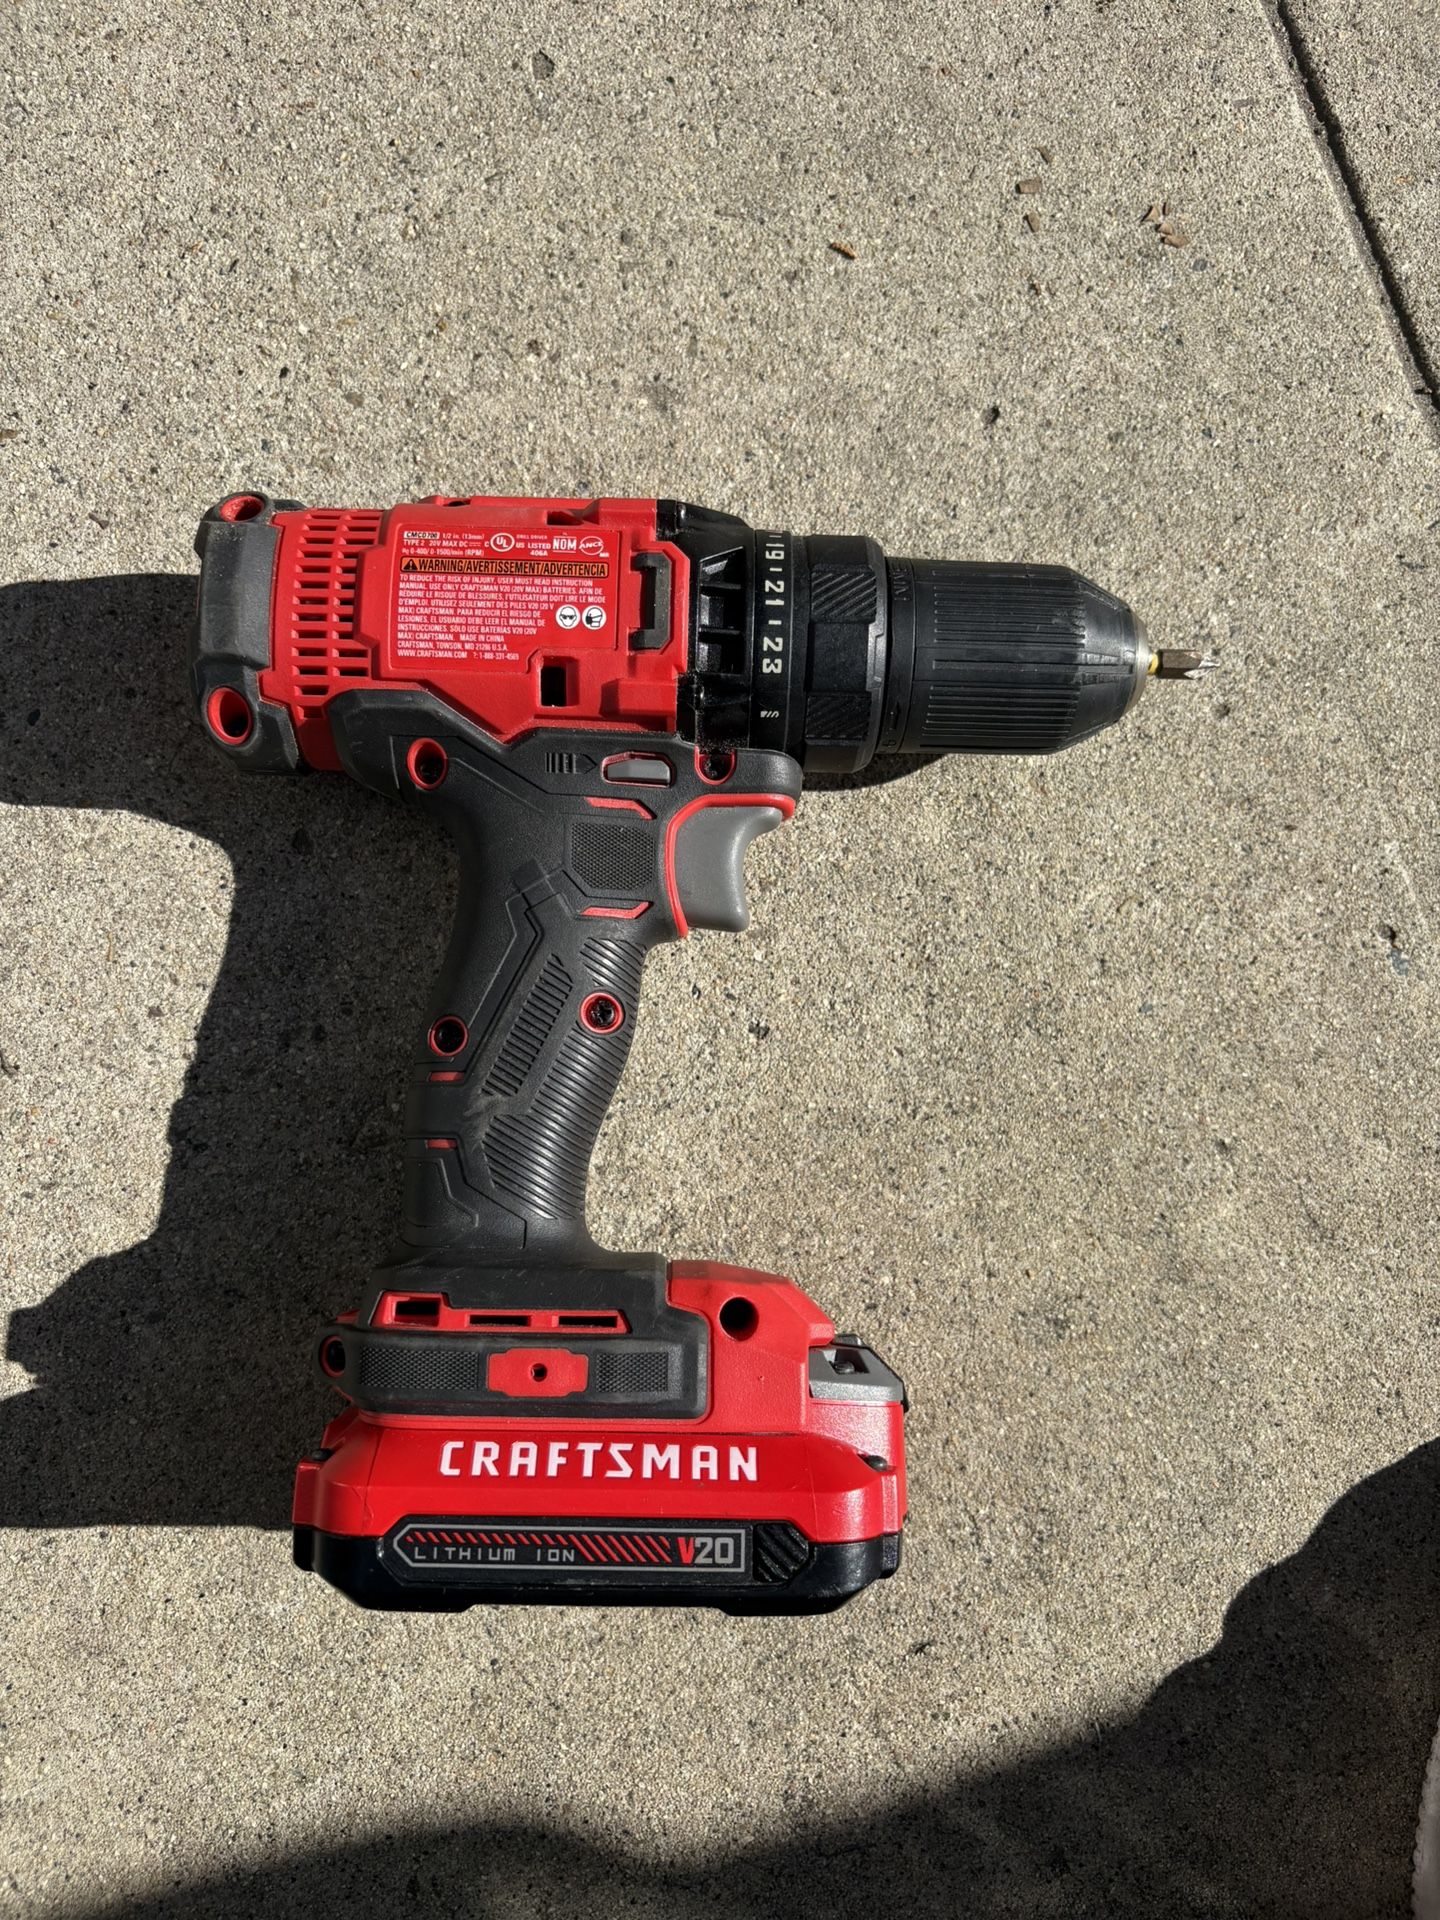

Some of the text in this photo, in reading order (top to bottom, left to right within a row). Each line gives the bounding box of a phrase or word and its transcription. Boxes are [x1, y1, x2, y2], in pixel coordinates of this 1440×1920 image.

[496, 536, 509, 548] UL
[553, 539, 576, 550] NOM
[764, 580, 784, 607] 21
[762, 637, 784, 674] 23
[438, 1440, 759, 1482] CRAFTSMAN
[413, 1545, 576, 1563] LITHIUM ION
[678, 1536, 734, 1564] V20
